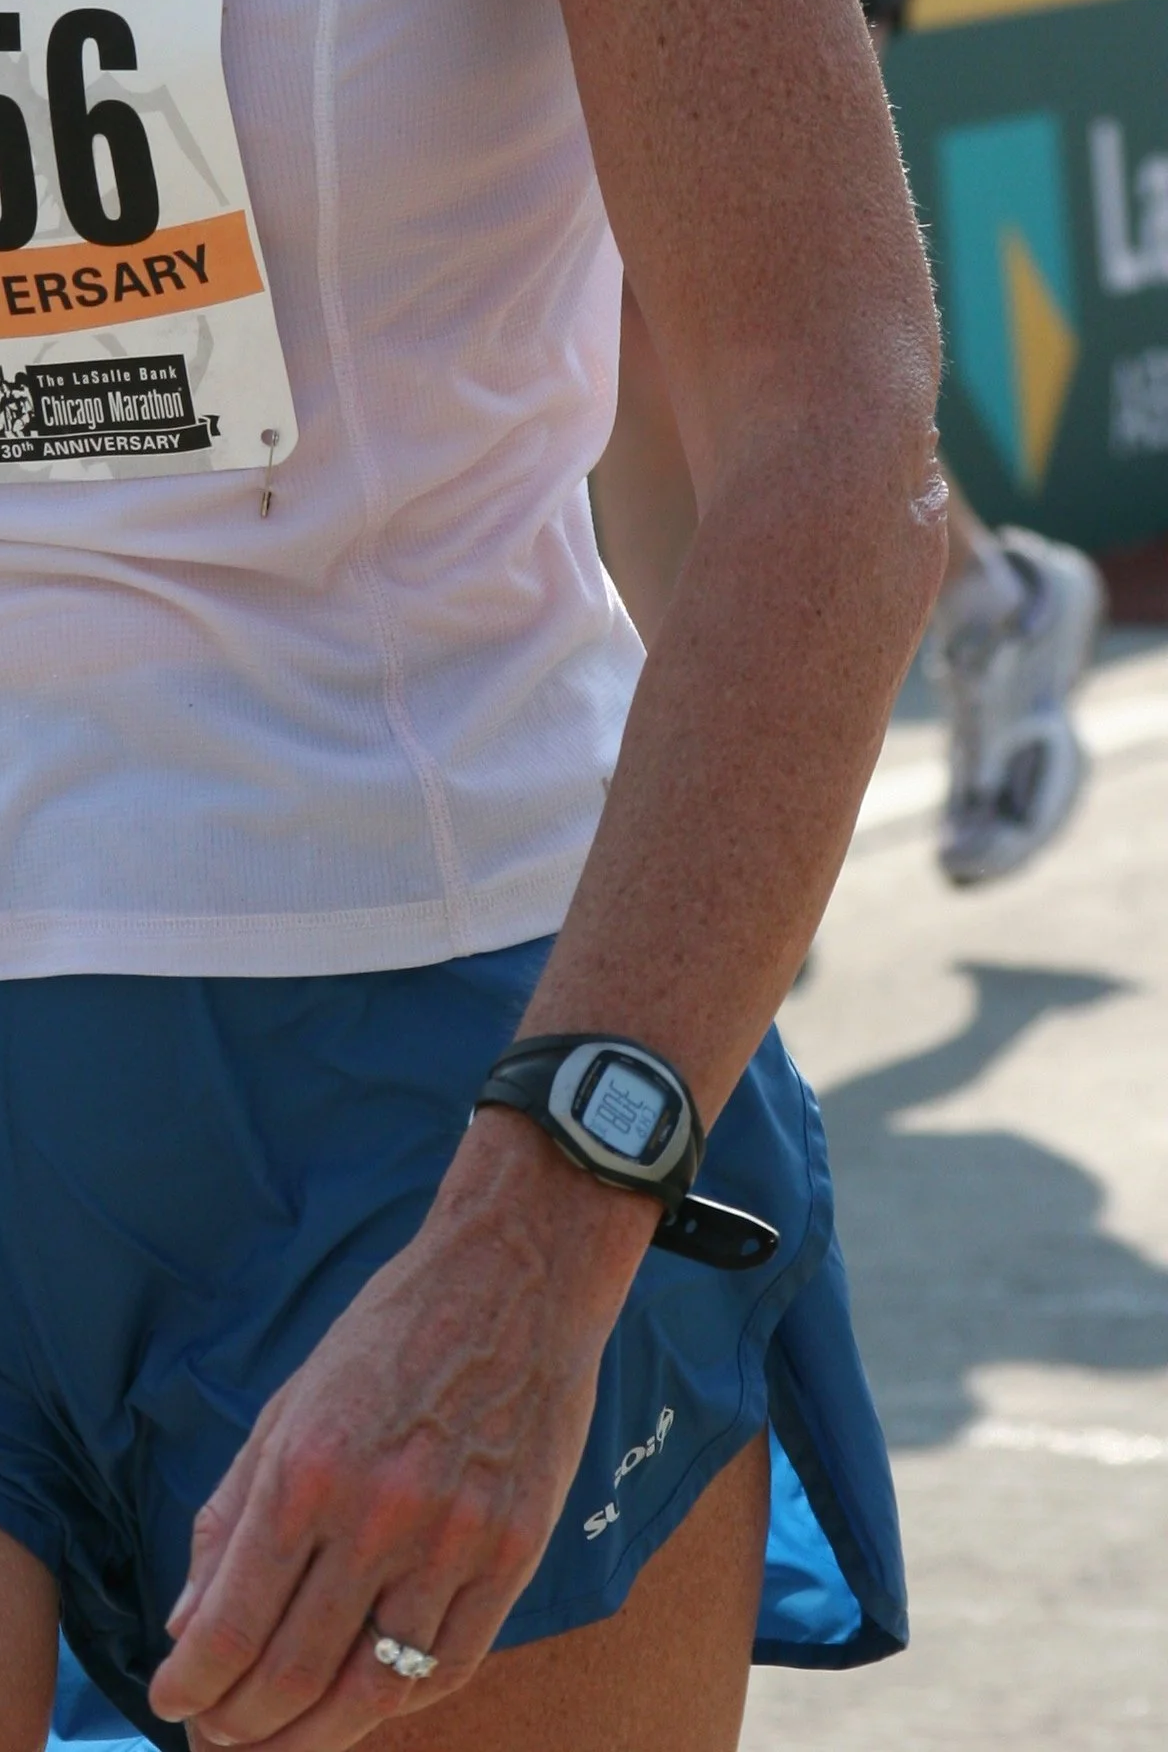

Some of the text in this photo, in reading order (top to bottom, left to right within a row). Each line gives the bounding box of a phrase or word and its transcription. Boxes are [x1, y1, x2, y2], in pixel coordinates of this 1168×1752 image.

[37, 365, 177, 388] The LaSalle Bank
[41, 389, 183, 430] Chicago Marathon
[1, 433, 181, 459] 30th ANNIVERSARY
